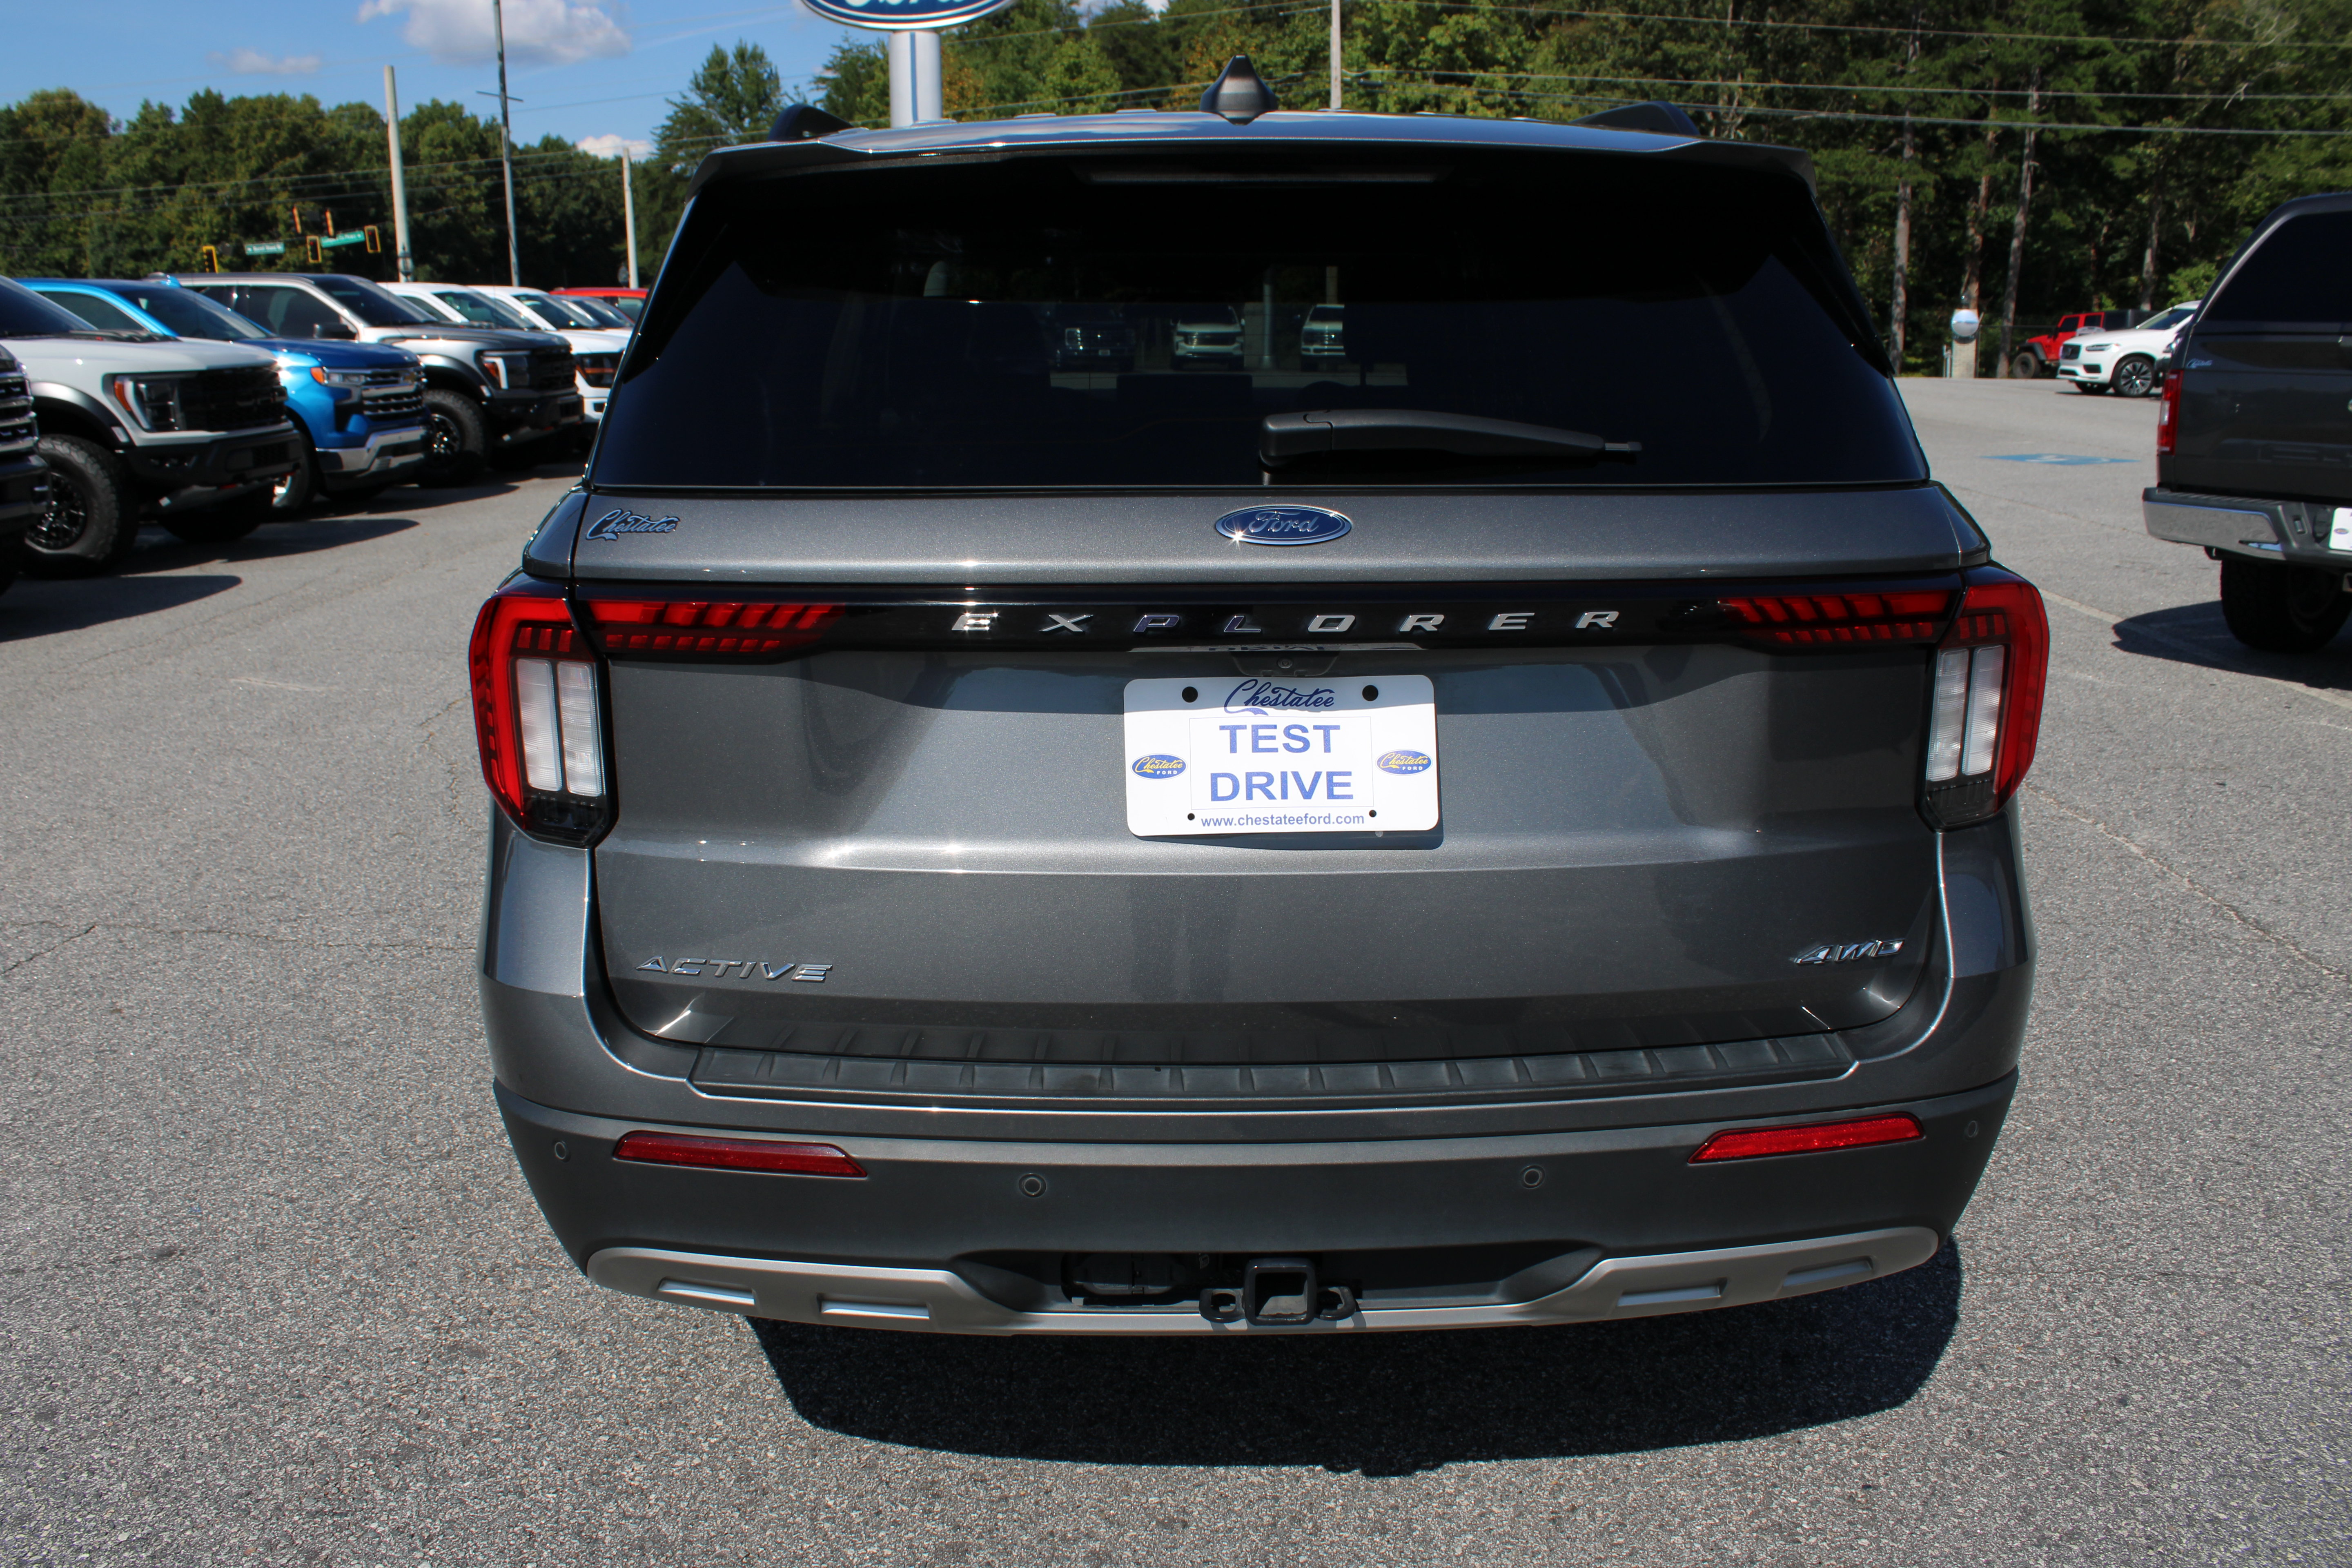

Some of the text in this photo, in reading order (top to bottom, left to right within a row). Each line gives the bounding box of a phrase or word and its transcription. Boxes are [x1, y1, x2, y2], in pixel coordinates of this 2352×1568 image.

[586, 509, 679, 541] Chestatee
[1248, 510, 1319, 532] Ford
[951, 611, 1619, 633] EXPLORER
[1224, 679, 1335, 716] Chestatee
[1219, 724, 1340, 753] TEST
[1135, 757, 1183, 773] Chestatee
[1380, 753, 1428, 768] Chestatee
[1210, 771, 1354, 802] DRIVE
[1200, 813, 1365, 827] www.chestateeford.com
[1793, 938, 1905, 964] 4WD
[635, 955, 832, 982] ACTIVE
